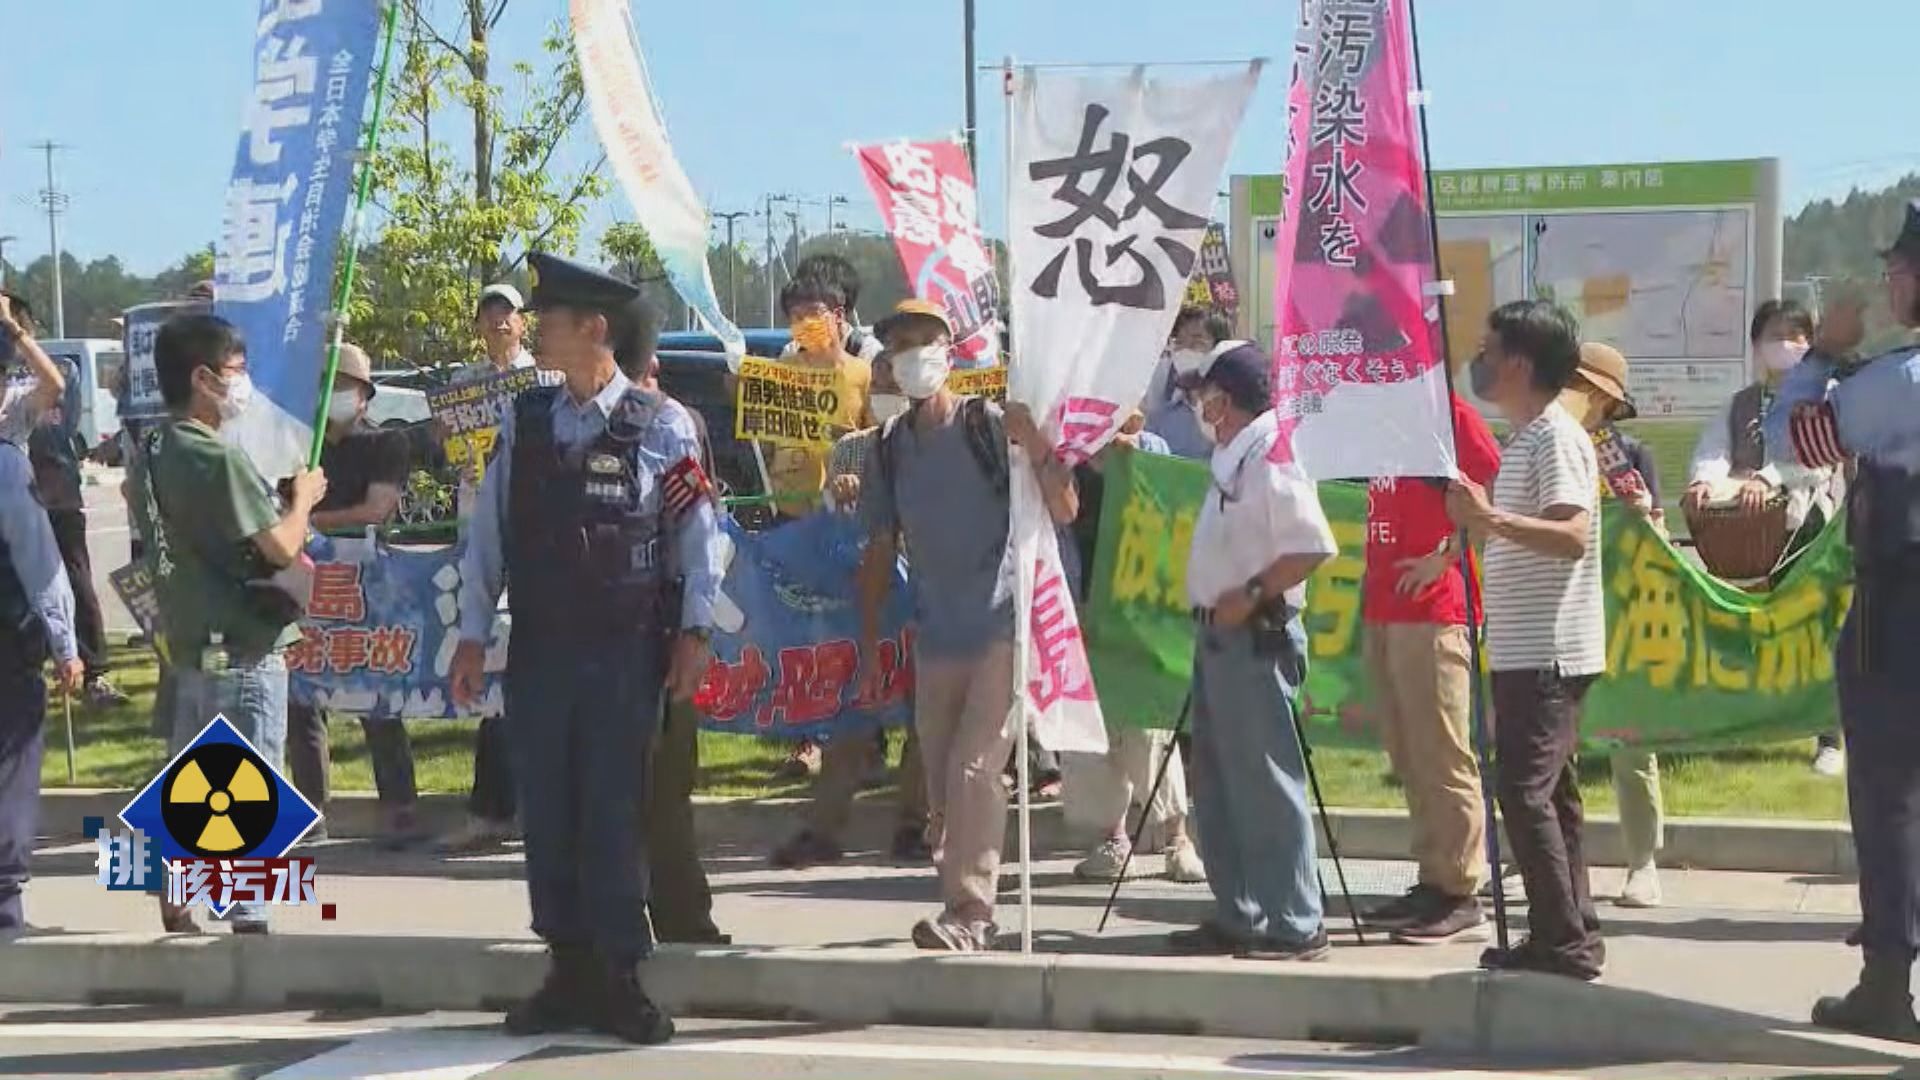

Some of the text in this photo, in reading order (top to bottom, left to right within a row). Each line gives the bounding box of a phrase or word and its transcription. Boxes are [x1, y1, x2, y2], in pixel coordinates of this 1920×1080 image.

[1028, 103, 1209, 310] 怒
[1307, 0, 1377, 266] 汚染水を
[743, 377, 838, 416] 原発推進の
[1605, 528, 1854, 694] 海に流
